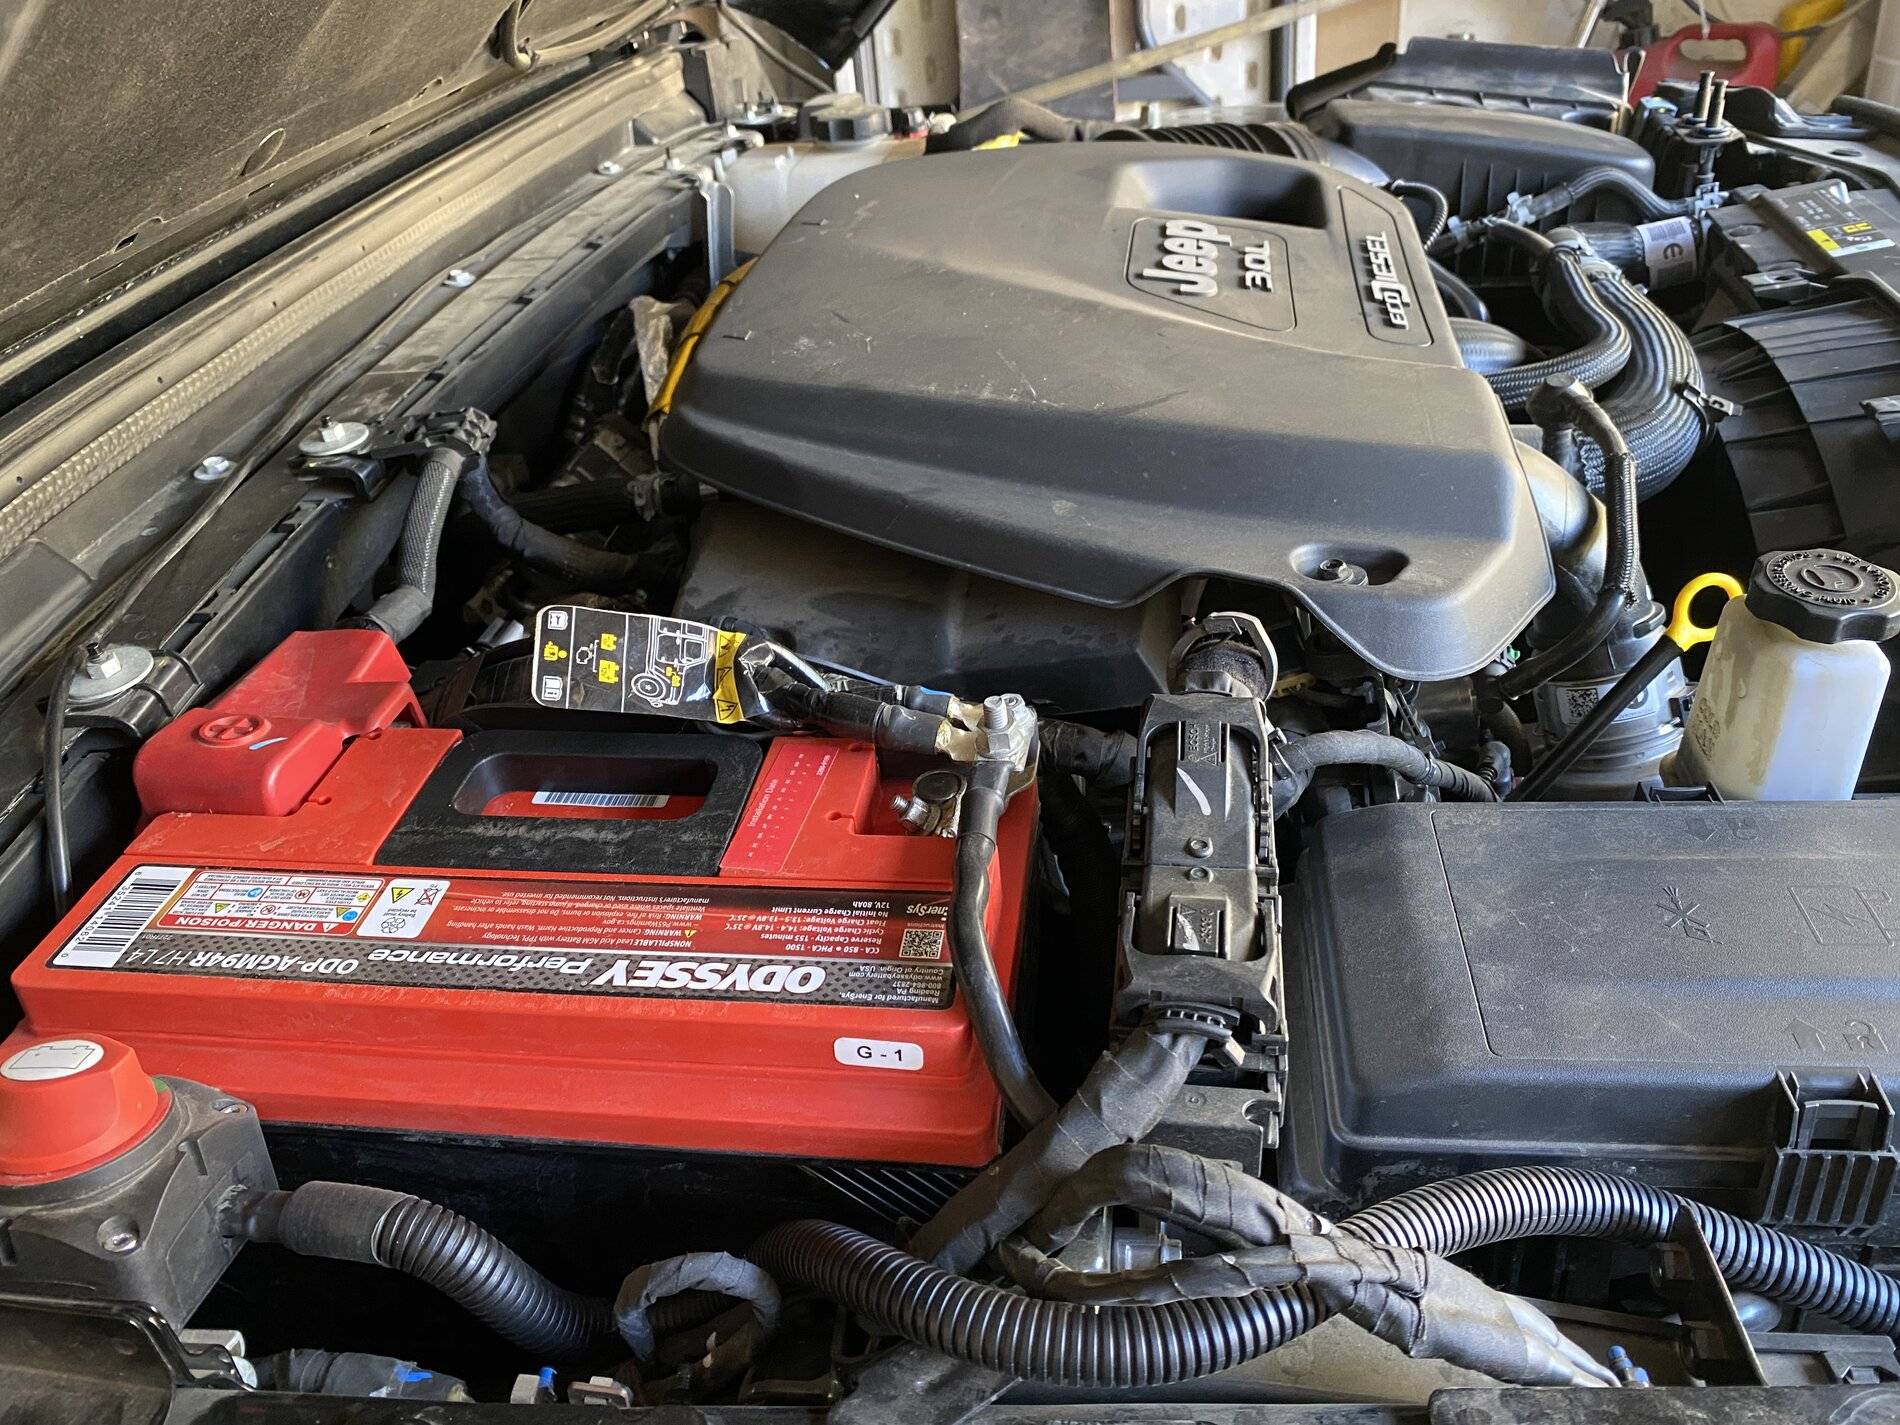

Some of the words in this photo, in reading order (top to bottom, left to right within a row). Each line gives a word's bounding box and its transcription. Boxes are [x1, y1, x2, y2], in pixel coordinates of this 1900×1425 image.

[1143, 220, 1232, 297] Jeep
[748, 793, 770, 827] Installation
[554, 893, 602, 901] recommended
[603, 894, 616, 902] Not
[617, 895, 658, 903] instructions.
[659, 896, 709, 905] manufacturer's
[874, 900, 890, 909] 12V,
[496, 907, 537, 915] disassemble
[591, 909, 624, 917] explosion
[771, 906, 792, 914] Limit
[793, 907, 823, 915] Current
[824, 907, 851, 916] Charge
[663, 913, 703, 921] WARNING:
[803, 916, 835, 924] Voltage:
[176, 916, 317, 932] DANGER/POISON
[447, 920, 477, 928] handling
[837, 917, 865, 926] Charge
[559, 924, 603, 933] Reproductive
[620, 927, 642, 935] Cancer
[642, 928, 682, 937] WARNING:
[800, 924, 832, 933] Voltage:
[834, 926, 862, 934] Charge
[863, 927, 884, 935] Cyclic
[482, 932, 520, 941] Technology
[521, 934, 538, 942] TPPL
[555, 934, 582, 943] Battery
[760, 933, 793, 941] minutes
[815, 935, 849, 943] Capacity
[600, 937, 615, 945] Acid
[634, 938, 692, 948] NONSPILLABLE
[851, 937, 882, 945] Reserve
[190, 950, 359, 975] ODP-AGM94R
[368, 947, 592, 973] Performance
[914, 967, 944, 975] Country
[589, 959, 826, 994] ODYSSEY
[848, 971, 943, 981] www.odysseybattery.com
[909, 988, 940, 996] Reading
[839, 992, 873, 1001] EnerSys,
[888, 995, 939, 1004] Manufactured
[857, 1046, 872, 1058] G
[895, 1049, 902, 1061] 1
